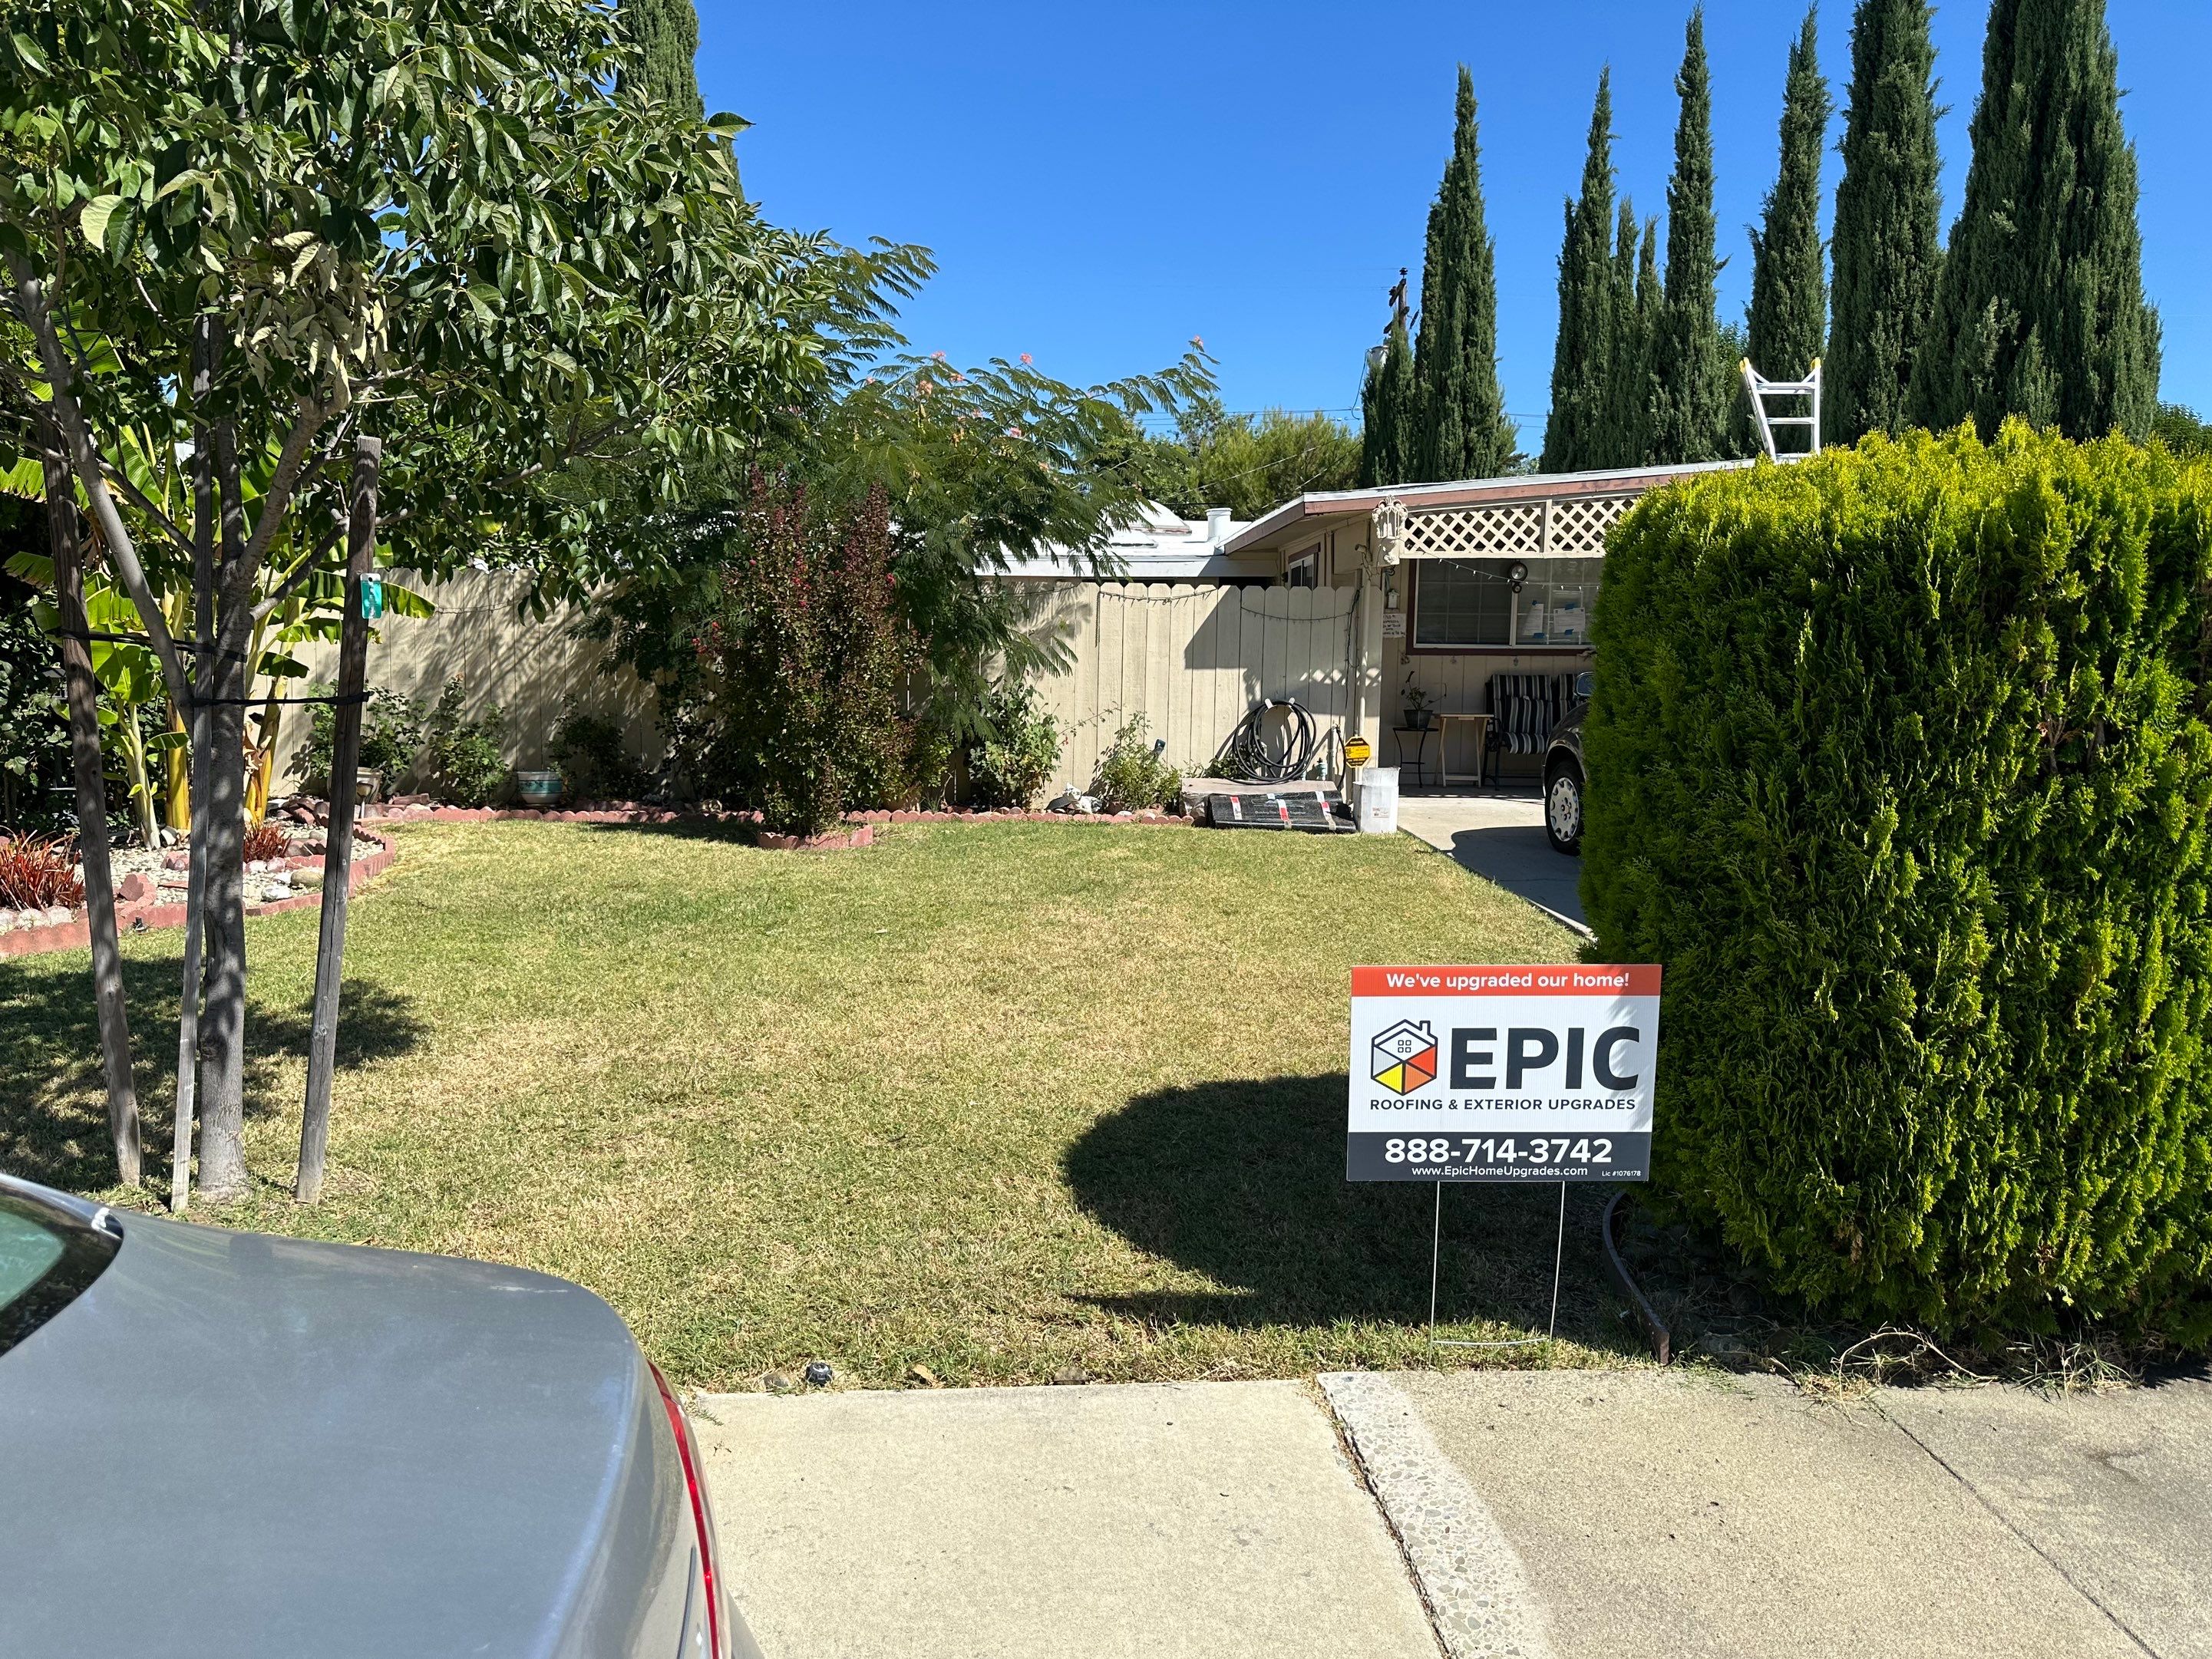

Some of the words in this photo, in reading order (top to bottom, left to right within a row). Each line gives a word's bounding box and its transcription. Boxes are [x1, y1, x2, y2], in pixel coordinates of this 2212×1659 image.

[1386, 973, 1441, 988] We've
[1446, 972, 1532, 991] upgraded
[1537, 975, 1568, 988] our
[1573, 972, 1629, 988] home!
[1449, 1026, 1640, 1091] EPIC
[1370, 1099, 1443, 1110] ROOFING
[1448, 1099, 1458, 1110] &
[1464, 1099, 1543, 1110] EXTERIOR
[1548, 1099, 1636, 1110] UPGRADES
[1385, 1138, 1613, 1163] 888-714-3742
[1411, 1165, 1588, 1178] www.EpicHomeUpgrades.com
